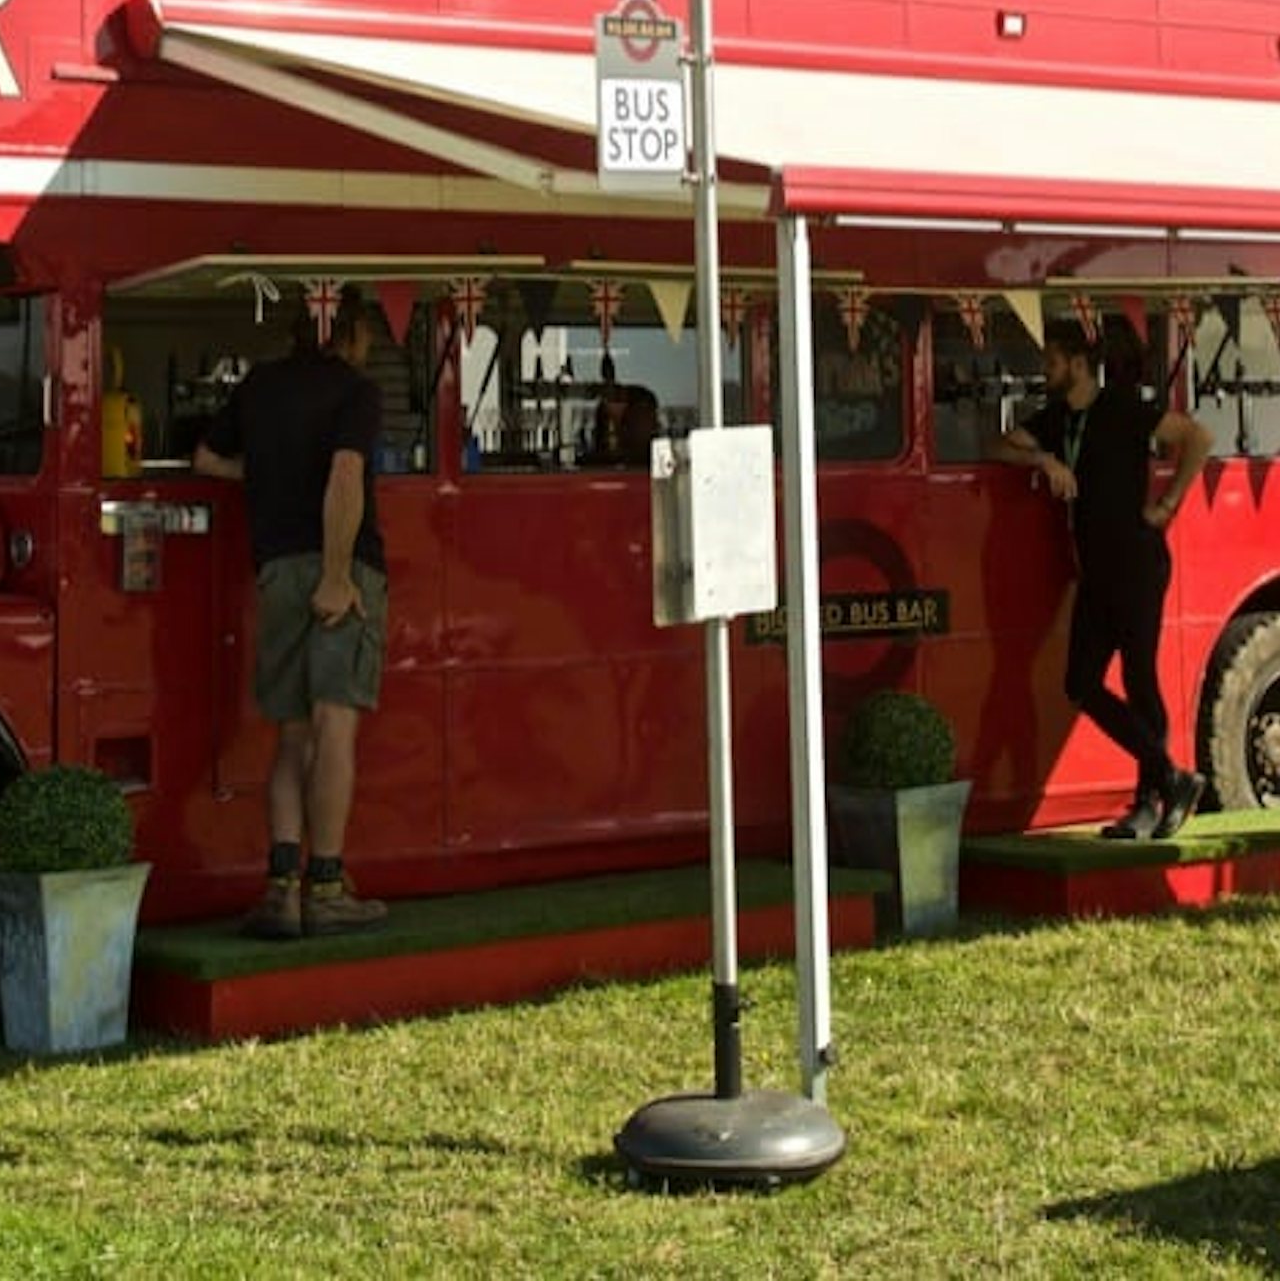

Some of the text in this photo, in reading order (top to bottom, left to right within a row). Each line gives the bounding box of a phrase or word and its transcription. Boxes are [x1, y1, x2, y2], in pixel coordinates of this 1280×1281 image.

[614, 87, 671, 122] BUS
[607, 126, 679, 162] STOP
[849, 601, 891, 625] BUS
[895, 597, 939, 628] BAR
